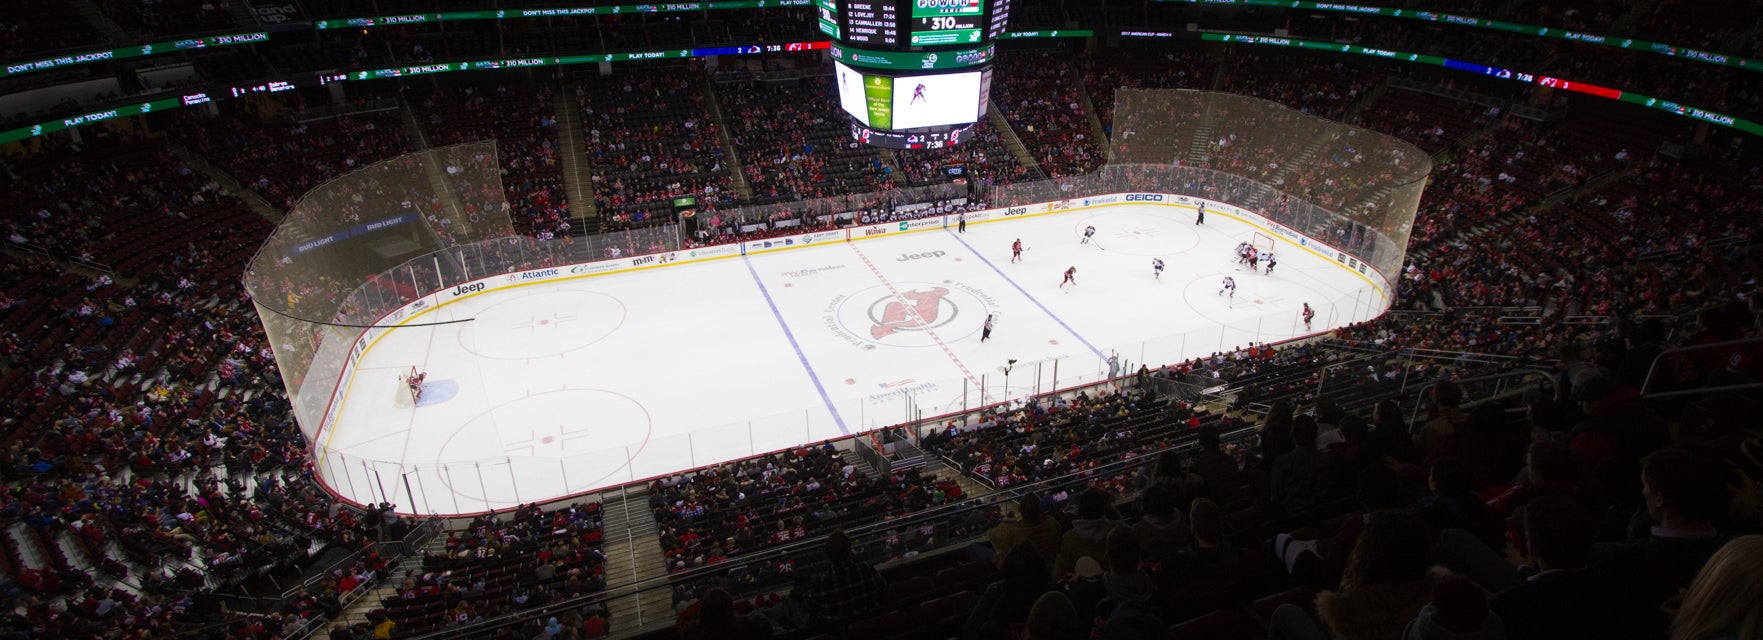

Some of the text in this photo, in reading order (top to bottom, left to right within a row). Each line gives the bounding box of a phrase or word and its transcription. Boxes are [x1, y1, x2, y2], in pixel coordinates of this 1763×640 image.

[931, 17, 955, 30] 310
[234, 33, 266, 42] MILLION
[7, 52, 113, 73] DON'T MISS THIS JACKPOT
[1698, 52, 1727, 63] MILLION
[64, 111, 117, 127] PLAY TODAY!
[1704, 112, 1734, 125] MILLION
[926, 141, 943, 149] 7:36
[1005, 206, 1026, 216] Jeep
[367, 217, 402, 231] BUD LIGHT
[866, 226, 886, 236] Wawa
[314, 236, 333, 247] LIGHT
[896, 249, 946, 262] Jeep
[522, 268, 559, 280] Atlantic
[453, 281, 485, 296] Jeep
